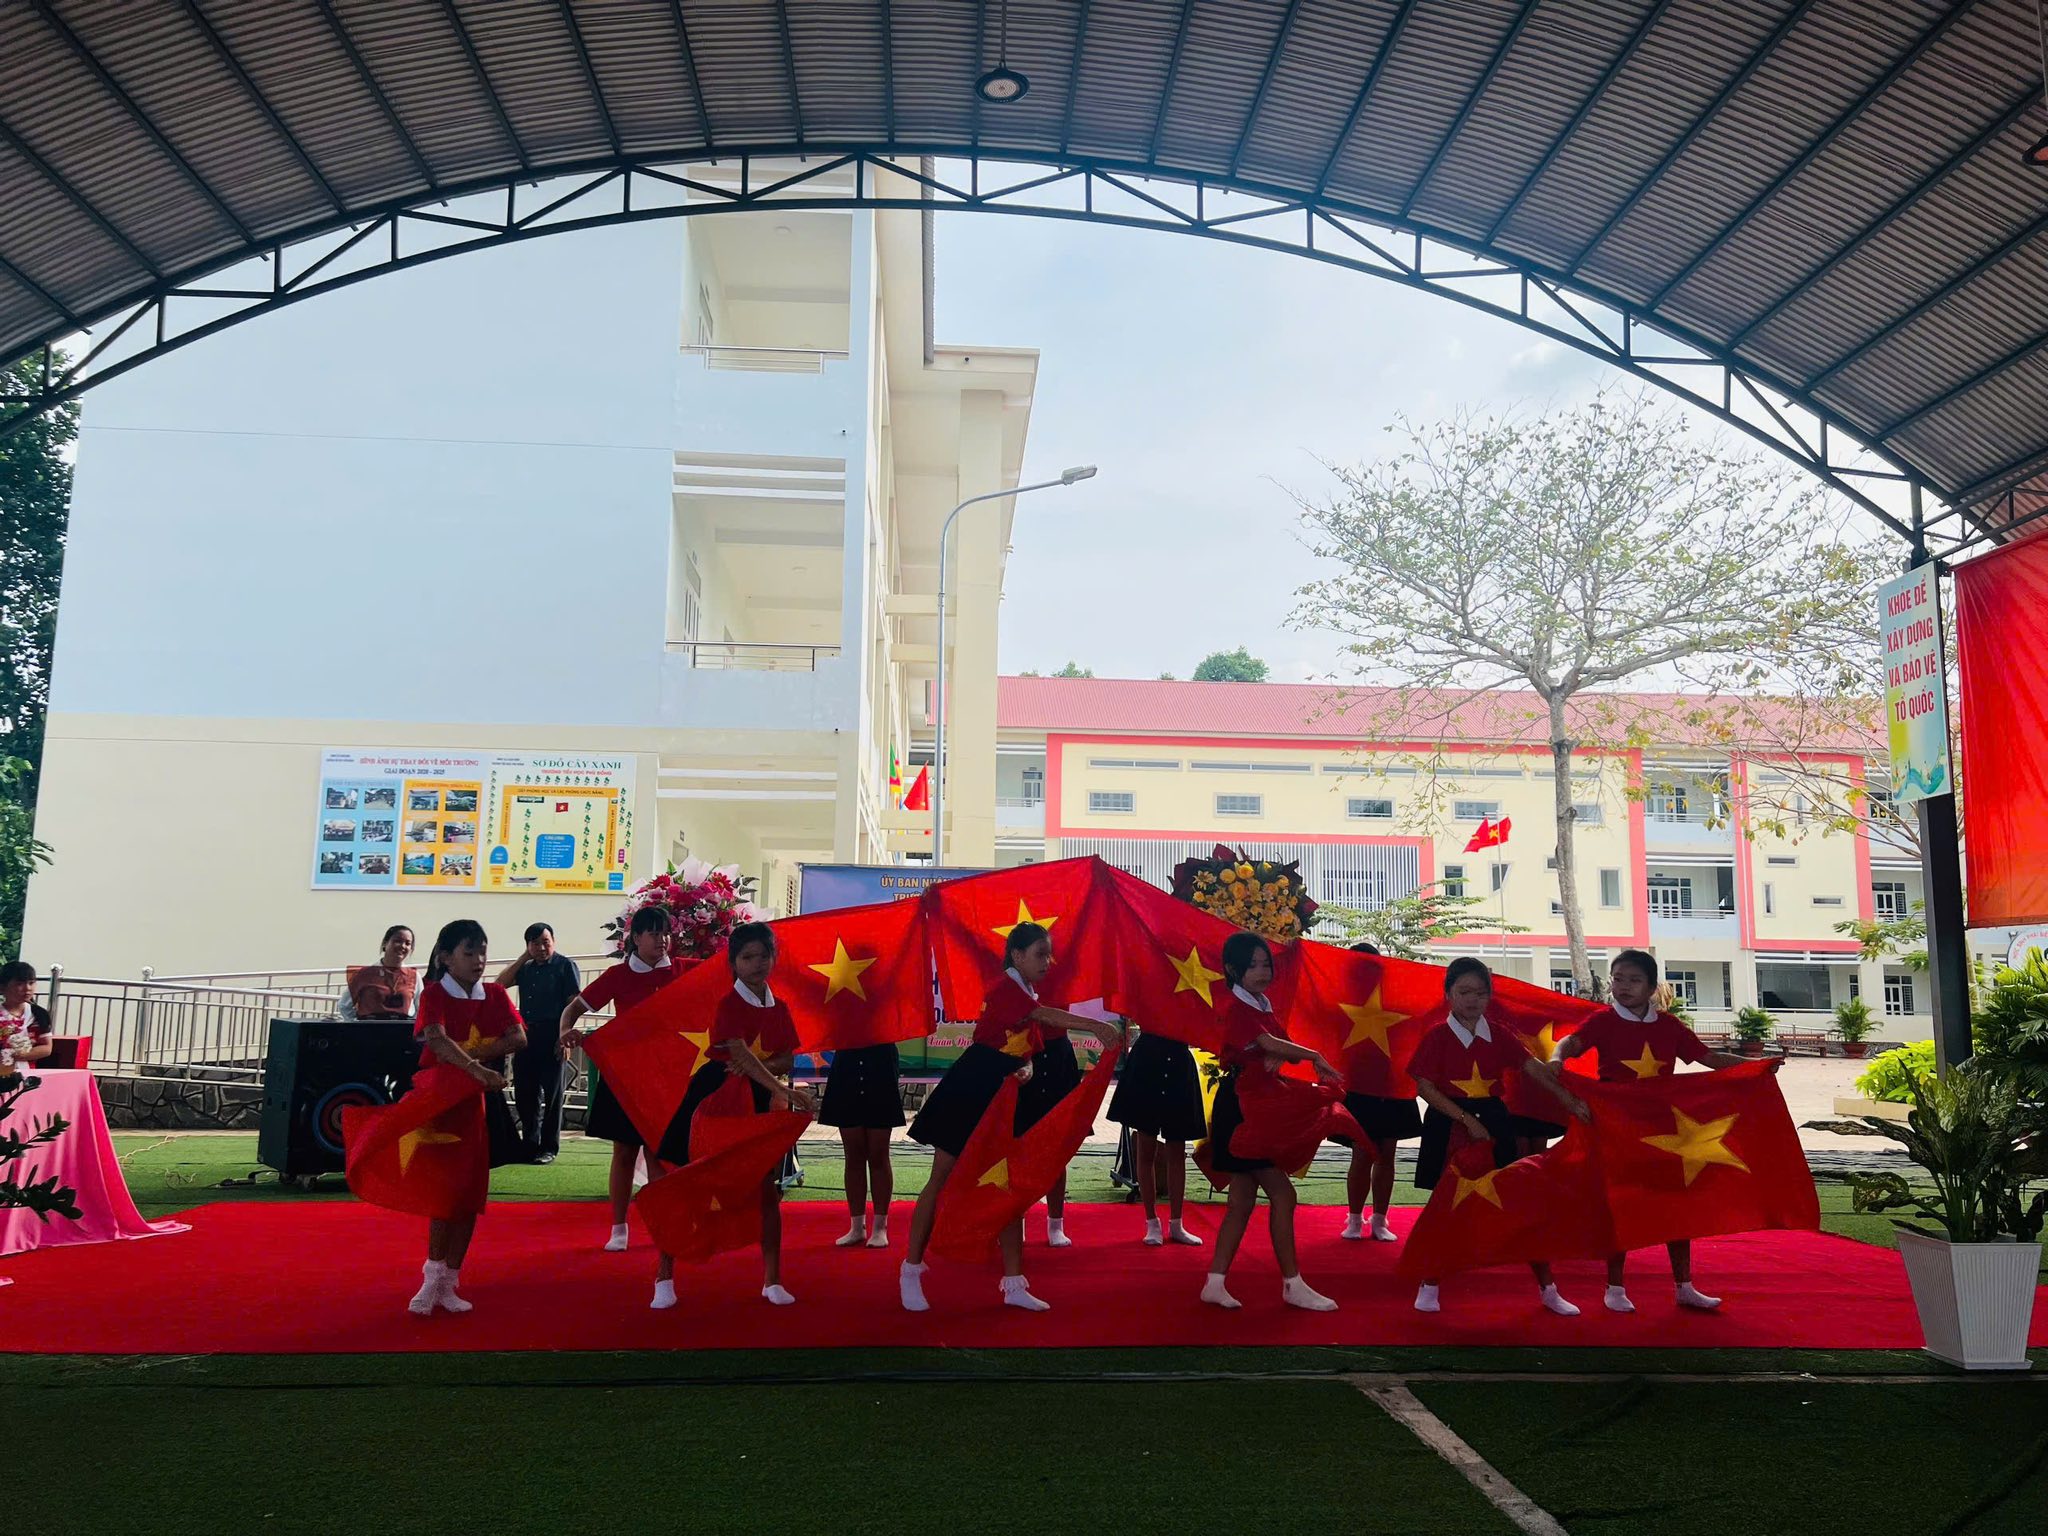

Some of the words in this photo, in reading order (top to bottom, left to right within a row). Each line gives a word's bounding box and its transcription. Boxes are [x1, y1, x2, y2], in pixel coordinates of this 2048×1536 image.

[1888, 585, 1912, 618] KHỎE
[1914, 573, 1927, 606] ĐỂ
[1887, 626, 1904, 654] XÂY
[1907, 616, 1934, 648] DỰNG
[1888, 662, 1901, 688] VÀ
[1902, 654, 1922, 684] BẢO
[1924, 648, 1937, 679] VỆ
[1894, 692, 1907, 722] TỔ
[1909, 684, 1935, 720] QUỐC
[532, 759, 547, 768] SƠ
[549, 757, 565, 768] ĐỒ
[567, 759, 589, 769] CÂY
[592, 761, 622, 770] XANH
[897, 877, 919, 889] BAN
